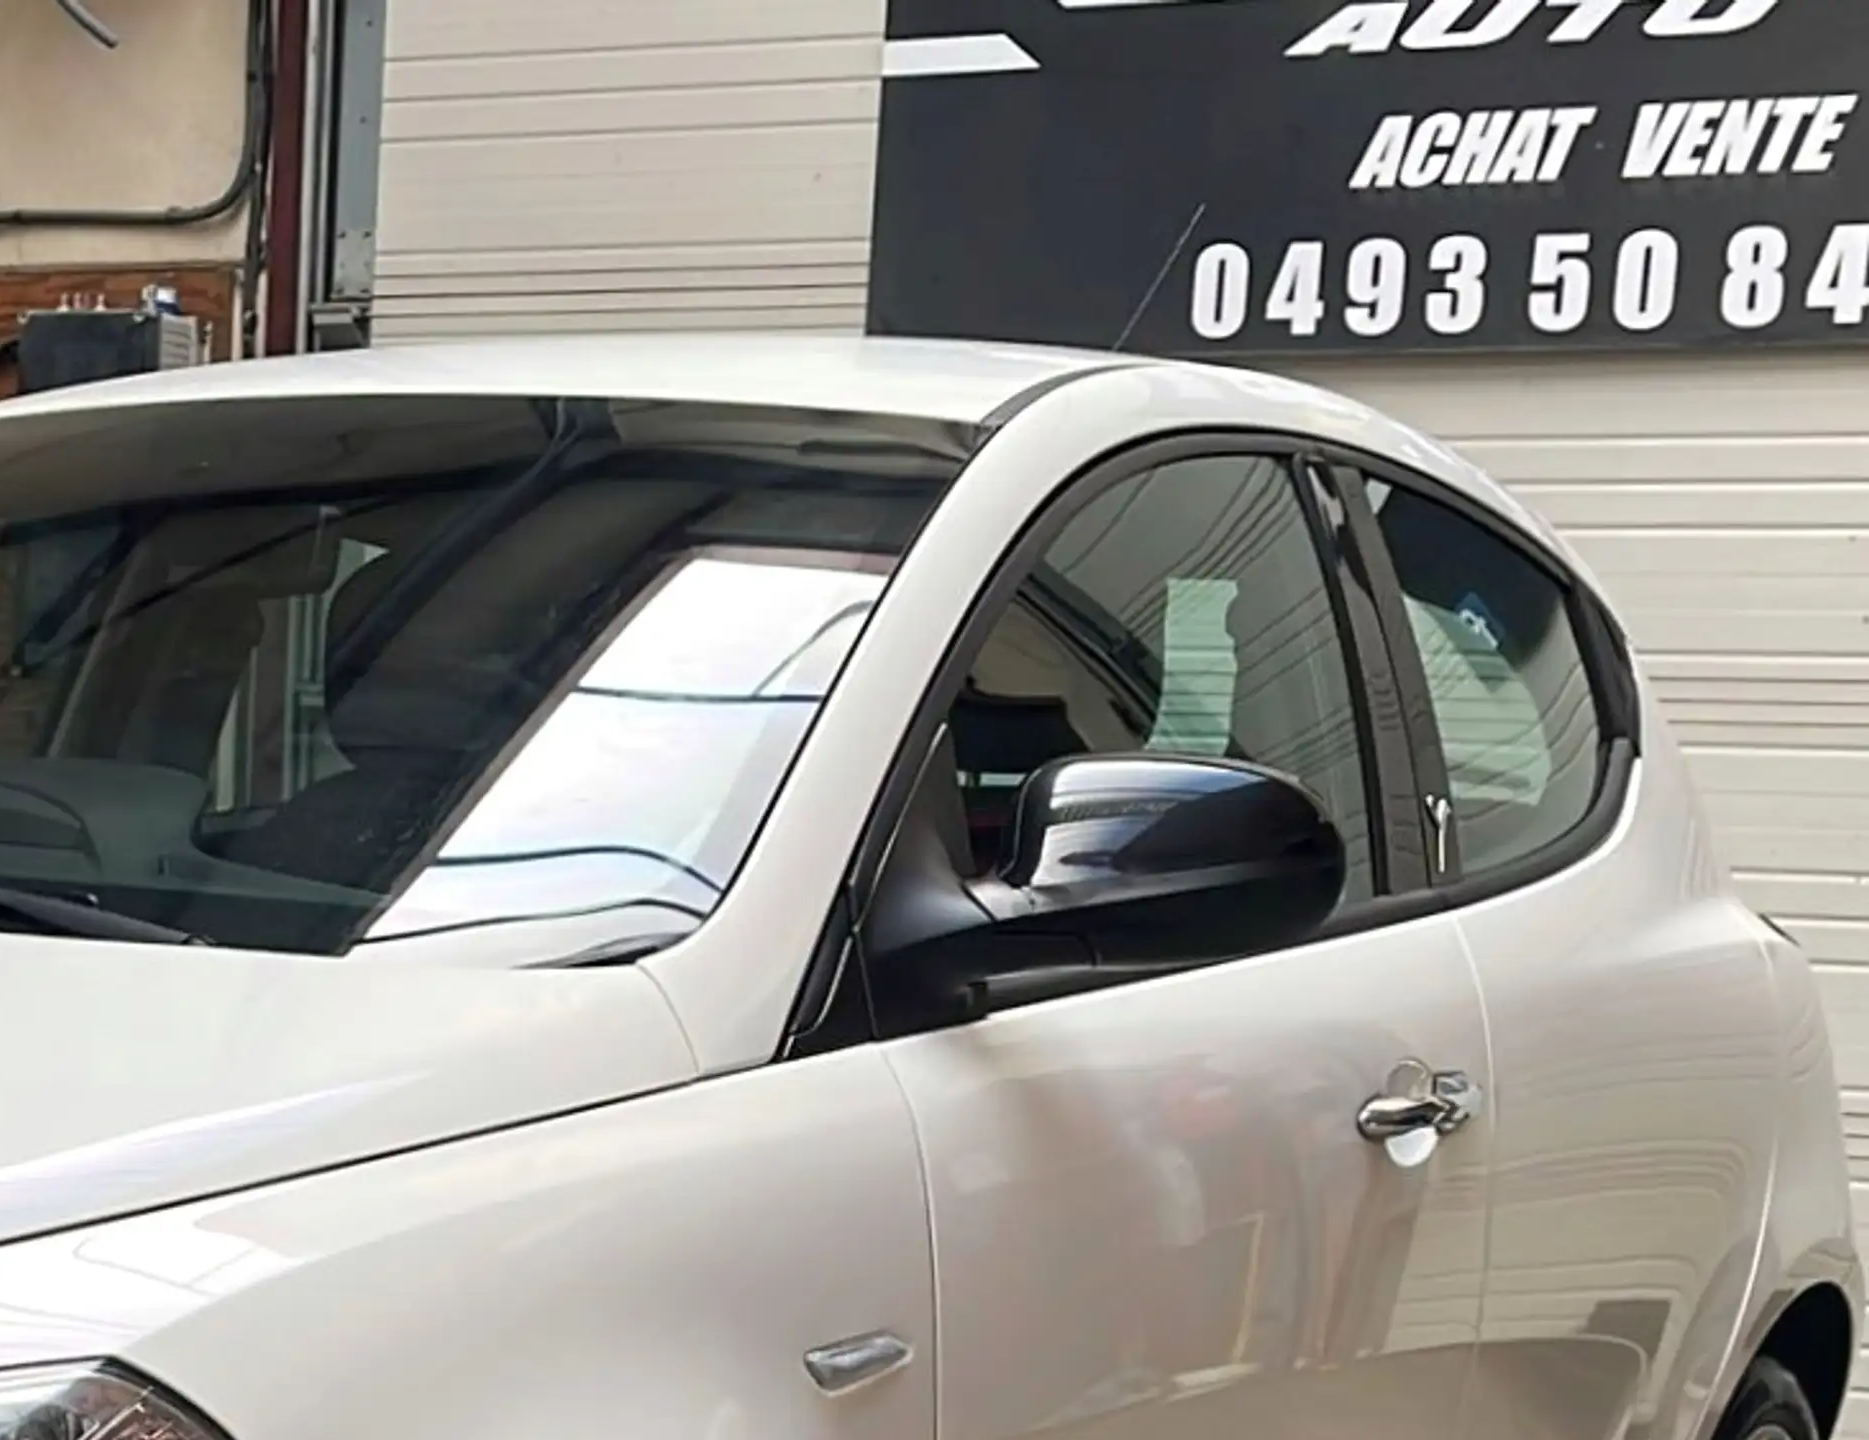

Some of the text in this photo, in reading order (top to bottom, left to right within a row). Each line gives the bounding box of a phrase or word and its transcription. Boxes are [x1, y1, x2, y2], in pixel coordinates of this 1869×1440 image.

[1348, 94, 1858, 189] ACHAT VENTE
[1191, 224, 1869, 339] 0493 50 84
